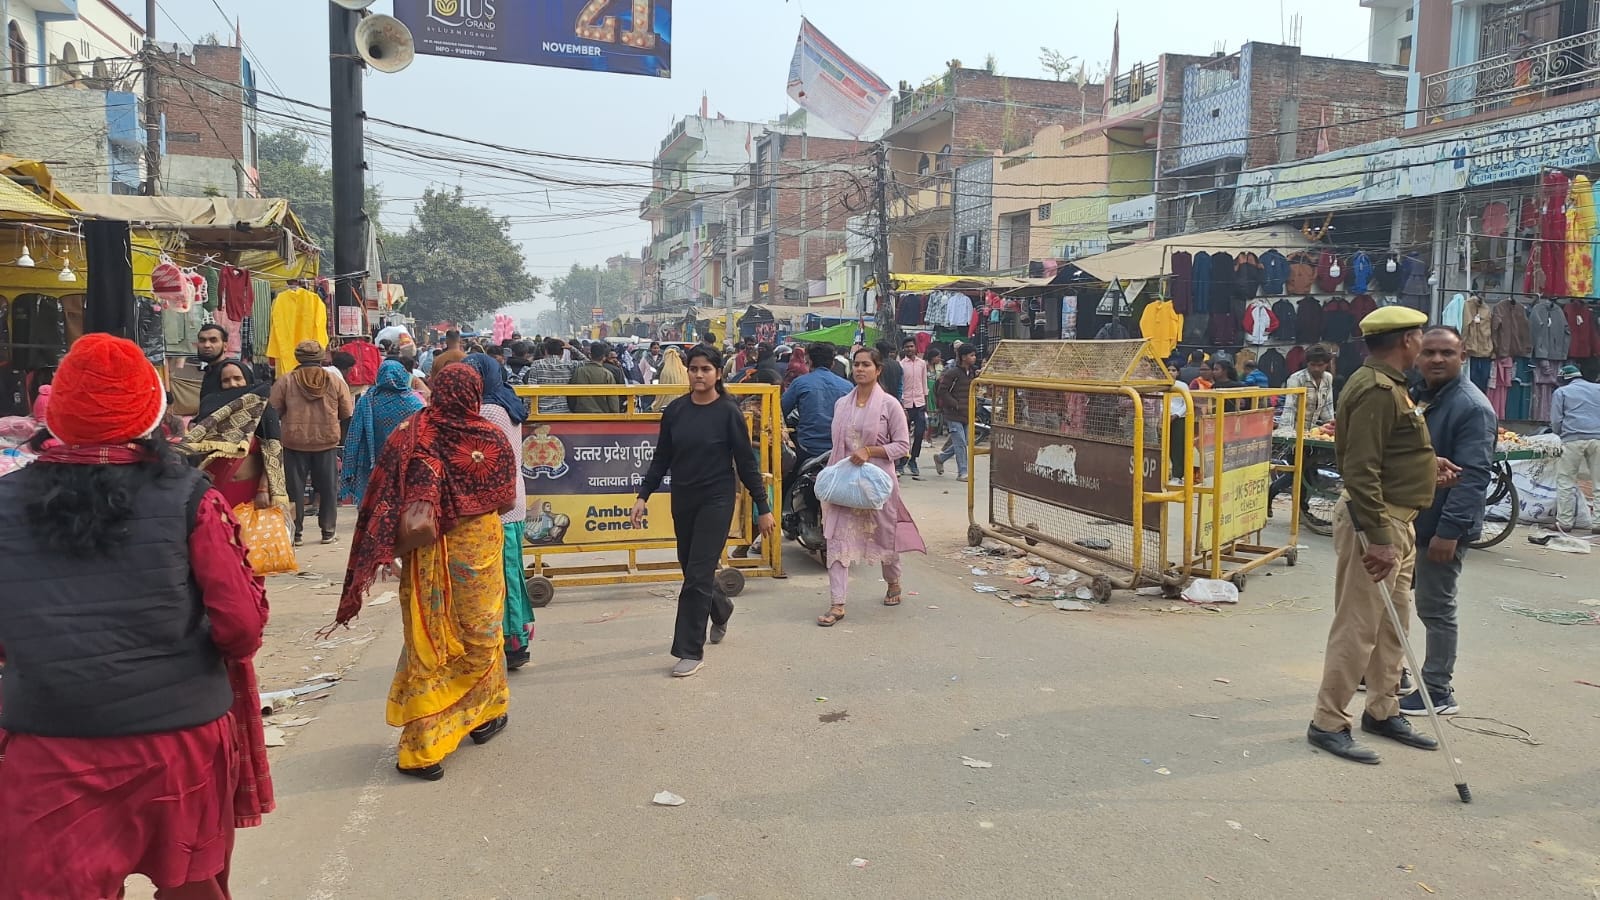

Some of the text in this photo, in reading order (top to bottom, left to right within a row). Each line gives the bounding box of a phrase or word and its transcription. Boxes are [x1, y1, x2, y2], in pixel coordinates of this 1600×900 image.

[465, 18, 496, 31] GRAND
[542, 41, 601, 56] NOVEMBER
[994, 433, 1015, 450] PLEASE
[573, 440, 657, 468] उत्तर प्रदेश पुलि
[1128, 455, 1157, 478] SOP
[588, 476, 628, 487] यातायात
[585, 505, 648, 518] Ambua
[584, 518, 648, 531] Cemet
